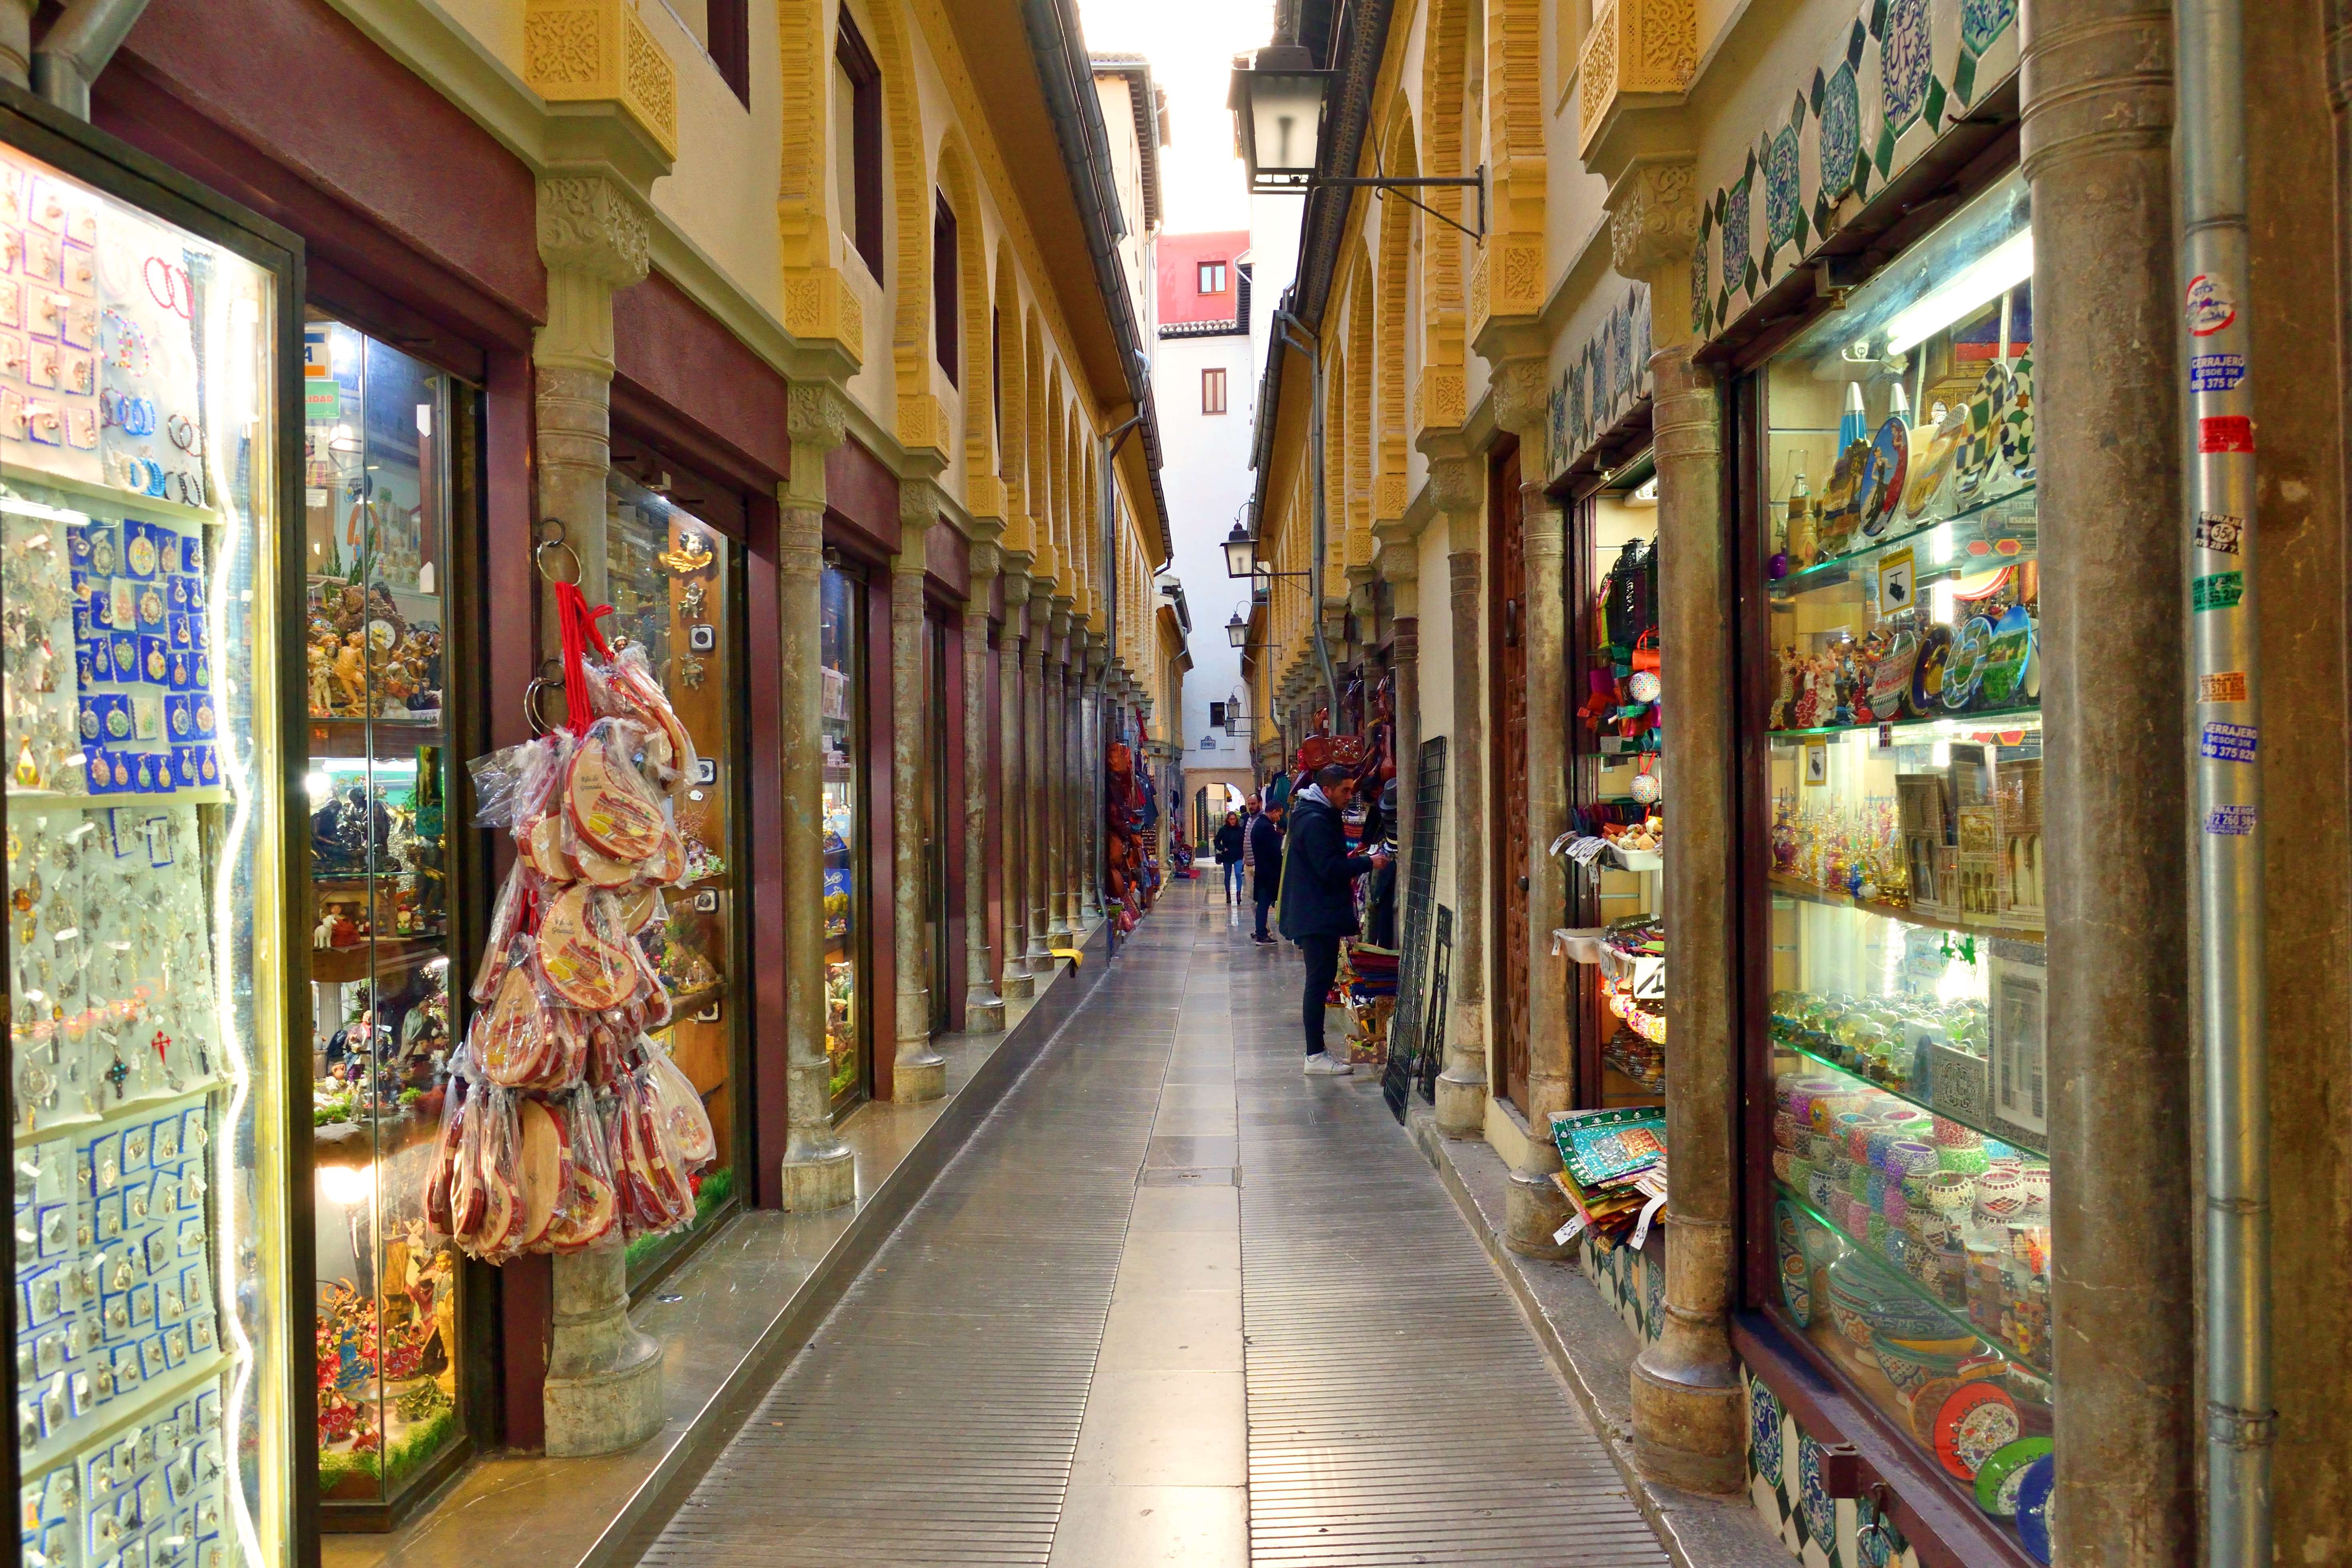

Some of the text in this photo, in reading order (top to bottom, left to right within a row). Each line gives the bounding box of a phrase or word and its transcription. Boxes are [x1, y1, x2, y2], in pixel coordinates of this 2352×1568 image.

[2192, 356, 2245, 369] CERRAJERO
[2207, 378, 2225, 388] 375
[2211, 682, 2226, 693] 570
[1880, 732, 1890, 740] JCB
[2204, 723, 2257, 739] CERRAJERO
[2208, 734, 2236, 745] DESDE
[2219, 746, 2237, 758] 375
[2222, 815, 2239, 825] 260
